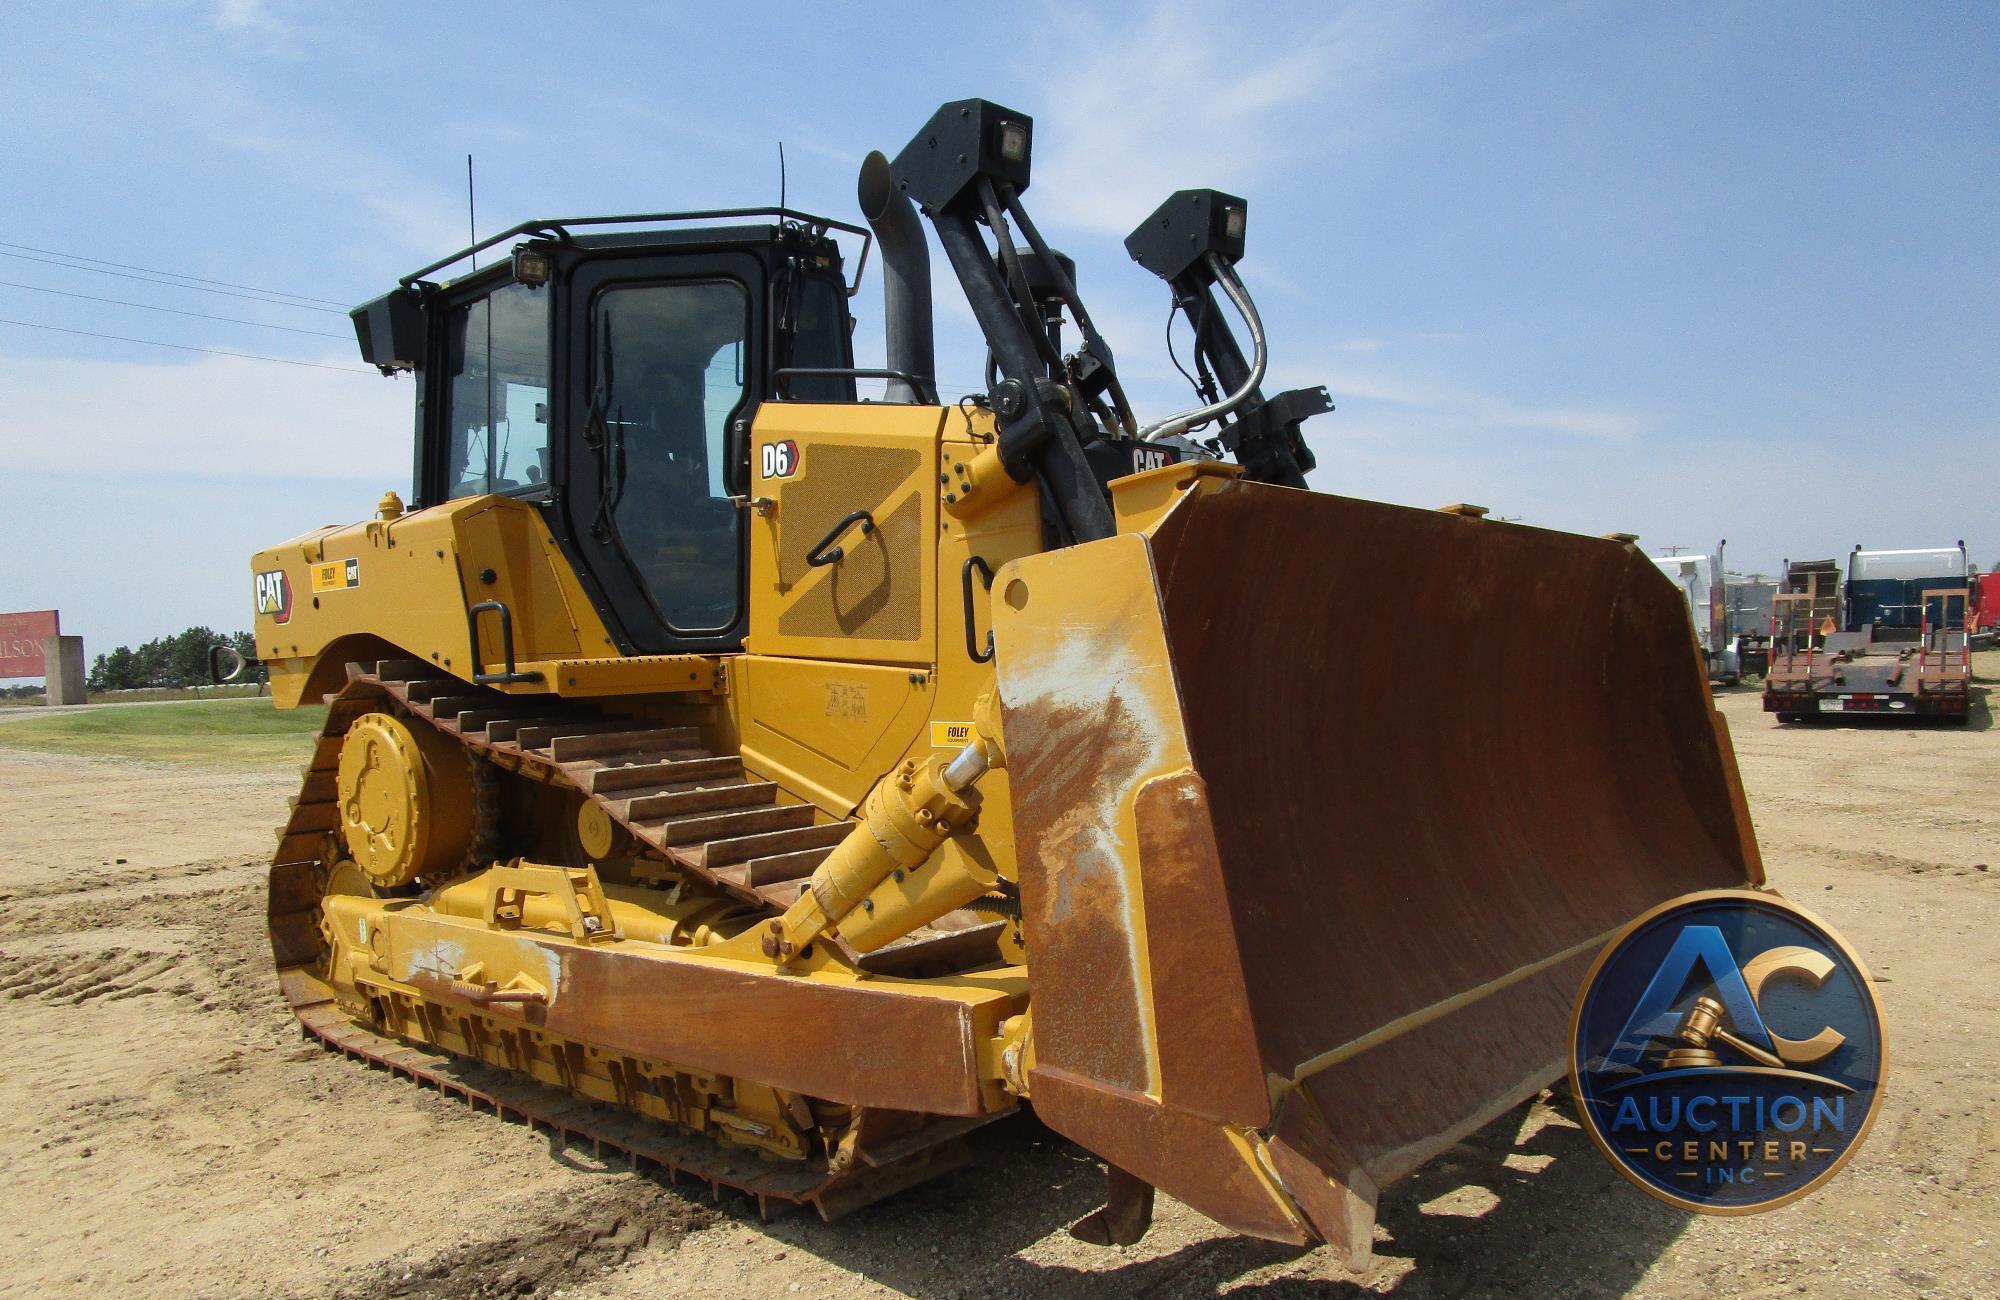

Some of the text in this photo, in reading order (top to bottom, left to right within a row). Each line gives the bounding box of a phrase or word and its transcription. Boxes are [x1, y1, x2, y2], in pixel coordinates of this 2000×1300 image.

[762, 442, 788, 477] D6
[1133, 448, 1165, 474] CAT
[346, 566, 358, 580] CAT
[256, 571, 283, 614] CAT
[947, 726, 969, 738] FOLEY
